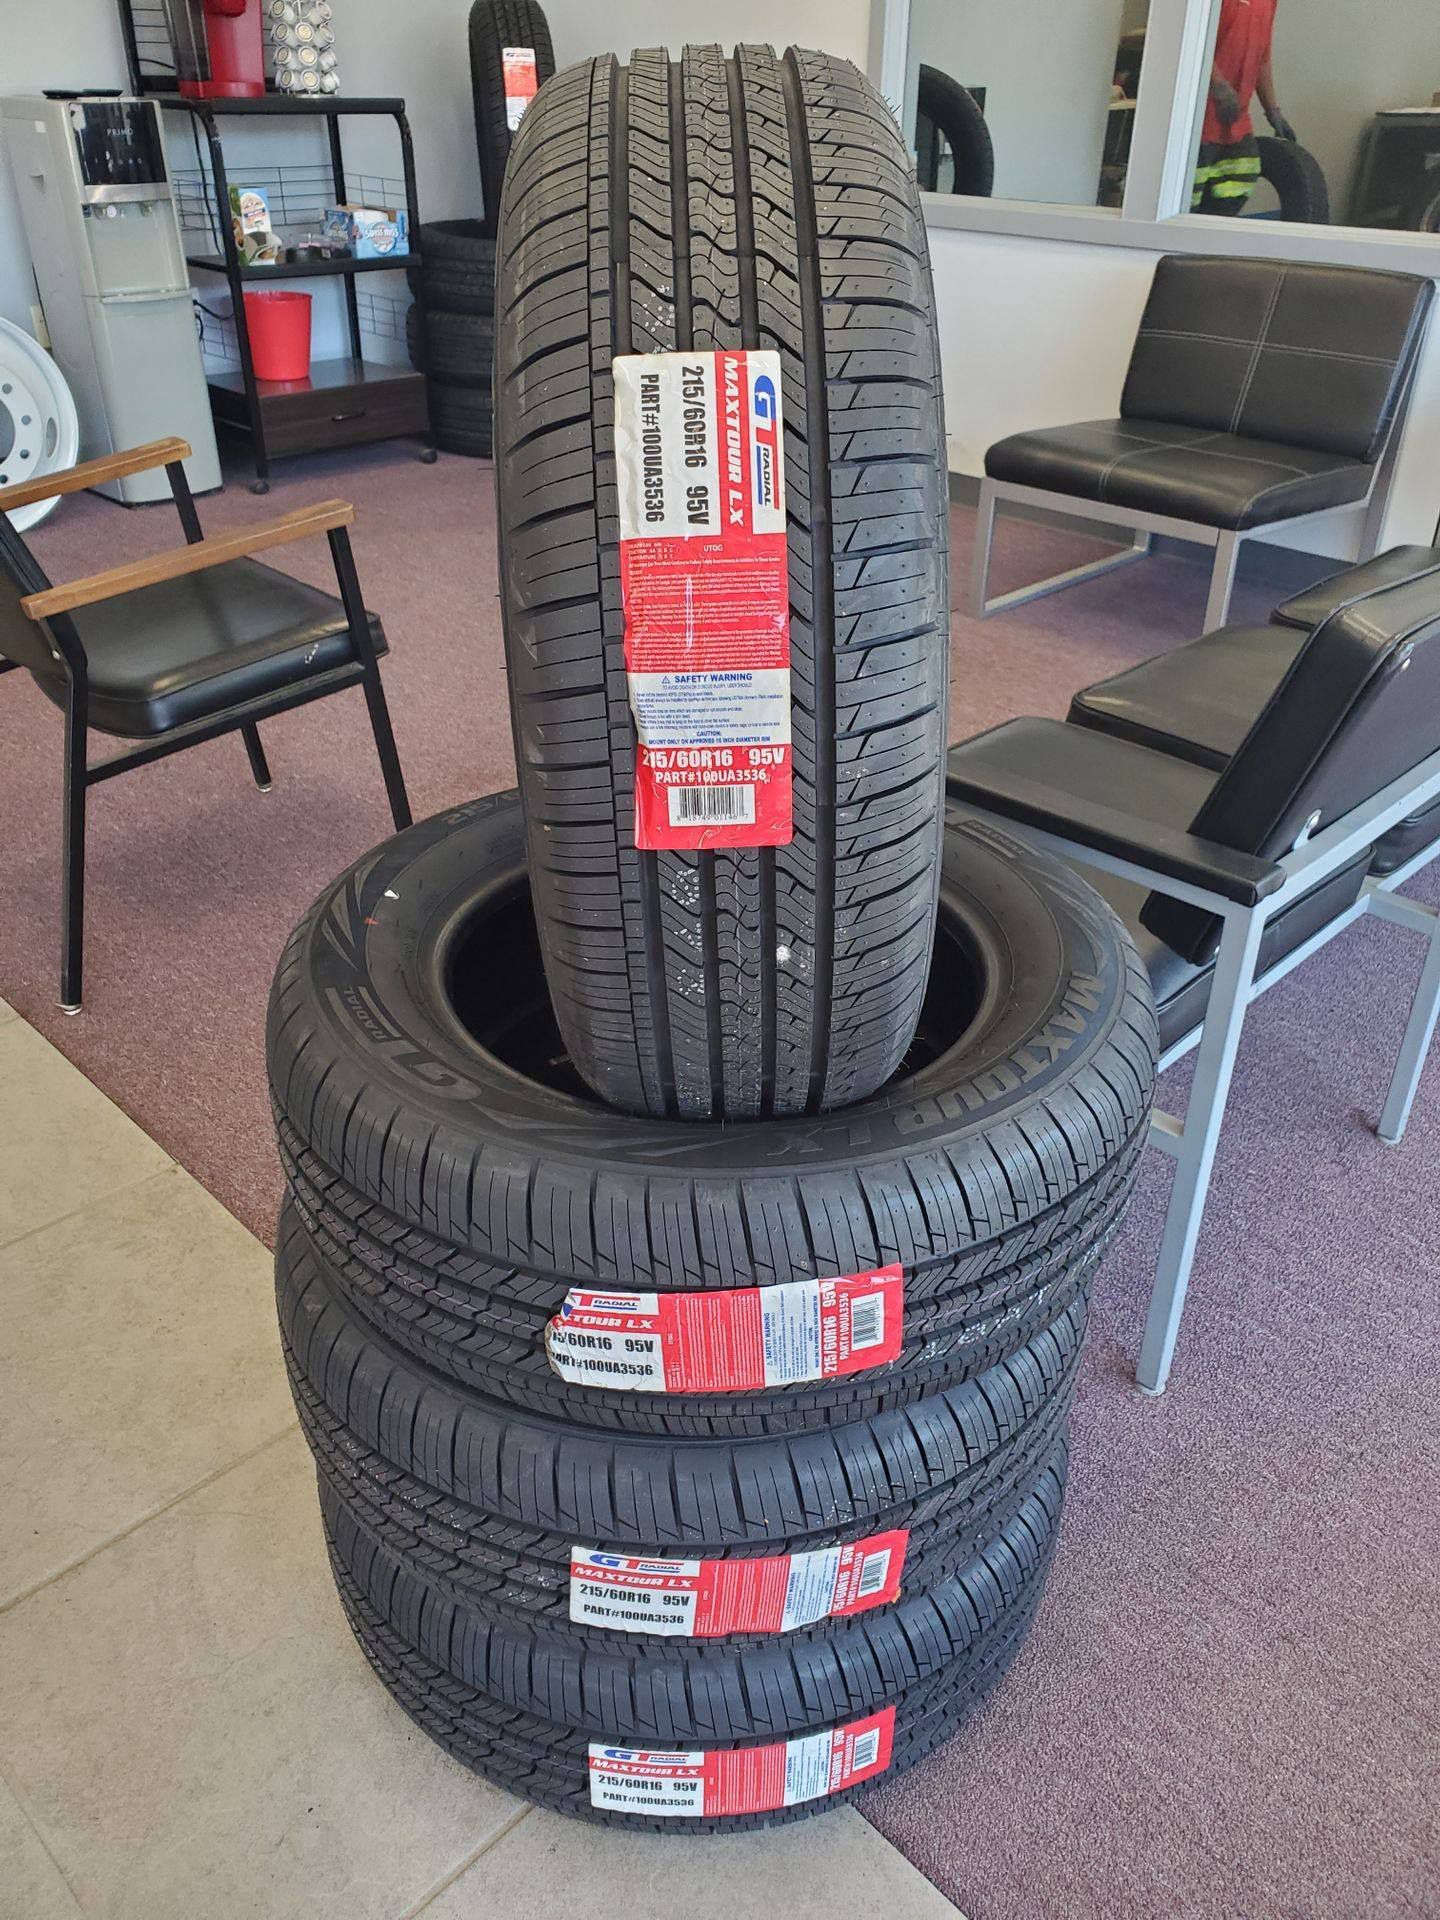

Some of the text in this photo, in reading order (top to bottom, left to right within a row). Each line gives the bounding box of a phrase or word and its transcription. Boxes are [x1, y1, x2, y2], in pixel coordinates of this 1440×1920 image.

[107, 128, 133, 136] PRIMO
[640, 374, 664, 522] PART#100UA3536
[682, 365, 710, 525] 215/60R16 95V
[723, 356, 744, 528] MAXTOUR LX
[762, 447, 770, 506] RADIAL
[674, 673, 752, 683] SAFETY WARNING
[642, 748, 784, 768] 215/60R16 95V
[656, 768, 766, 784] PART#100UA3536
[343, 985, 388, 1042] RADIAL
[626, 1319, 654, 1329] LX
[821, 1280, 837, 1373] 215/60R16 95V
[839, 1293, 850, 1360] PART#100UA3536
[625, 1339, 654, 1352] 95V
[575, 1567, 693, 1587] MAXTOUR LX
[580, 1584, 651, 1604] 215/60R16
[663, 1595, 690, 1606] 95V
[584, 1604, 684, 1624] PART#100UA3536
[592, 1759, 672, 1775] MAXTOUR
[599, 1774, 698, 1791] 215/60R16 95V
[603, 1792, 694, 1806] PART#100UA3536
